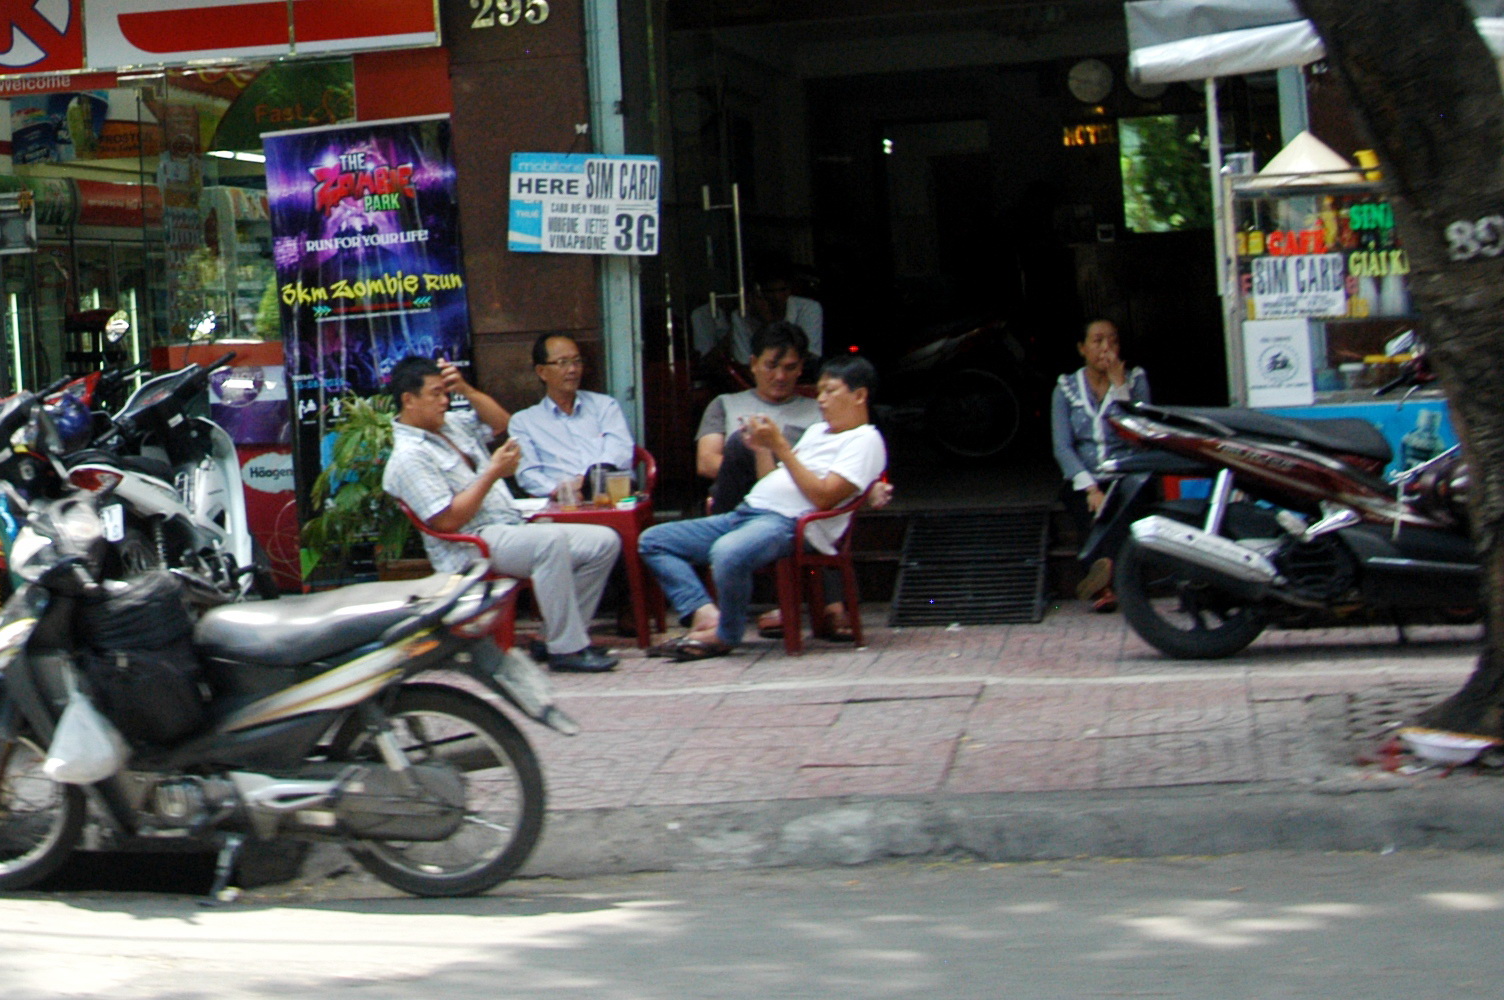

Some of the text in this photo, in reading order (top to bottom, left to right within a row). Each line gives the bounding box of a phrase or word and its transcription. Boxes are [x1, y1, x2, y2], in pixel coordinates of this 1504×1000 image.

[339, 153, 366, 172] THE
[517, 161, 658, 201] HERE SIM CARD
[363, 193, 401, 213] PARK
[306, 229, 429, 253] RUN FOR YOUR LIFE!
[615, 213, 656, 252] 3G
[329, 271, 419, 300] Zombie
[1254, 257, 1290, 295] SIM
